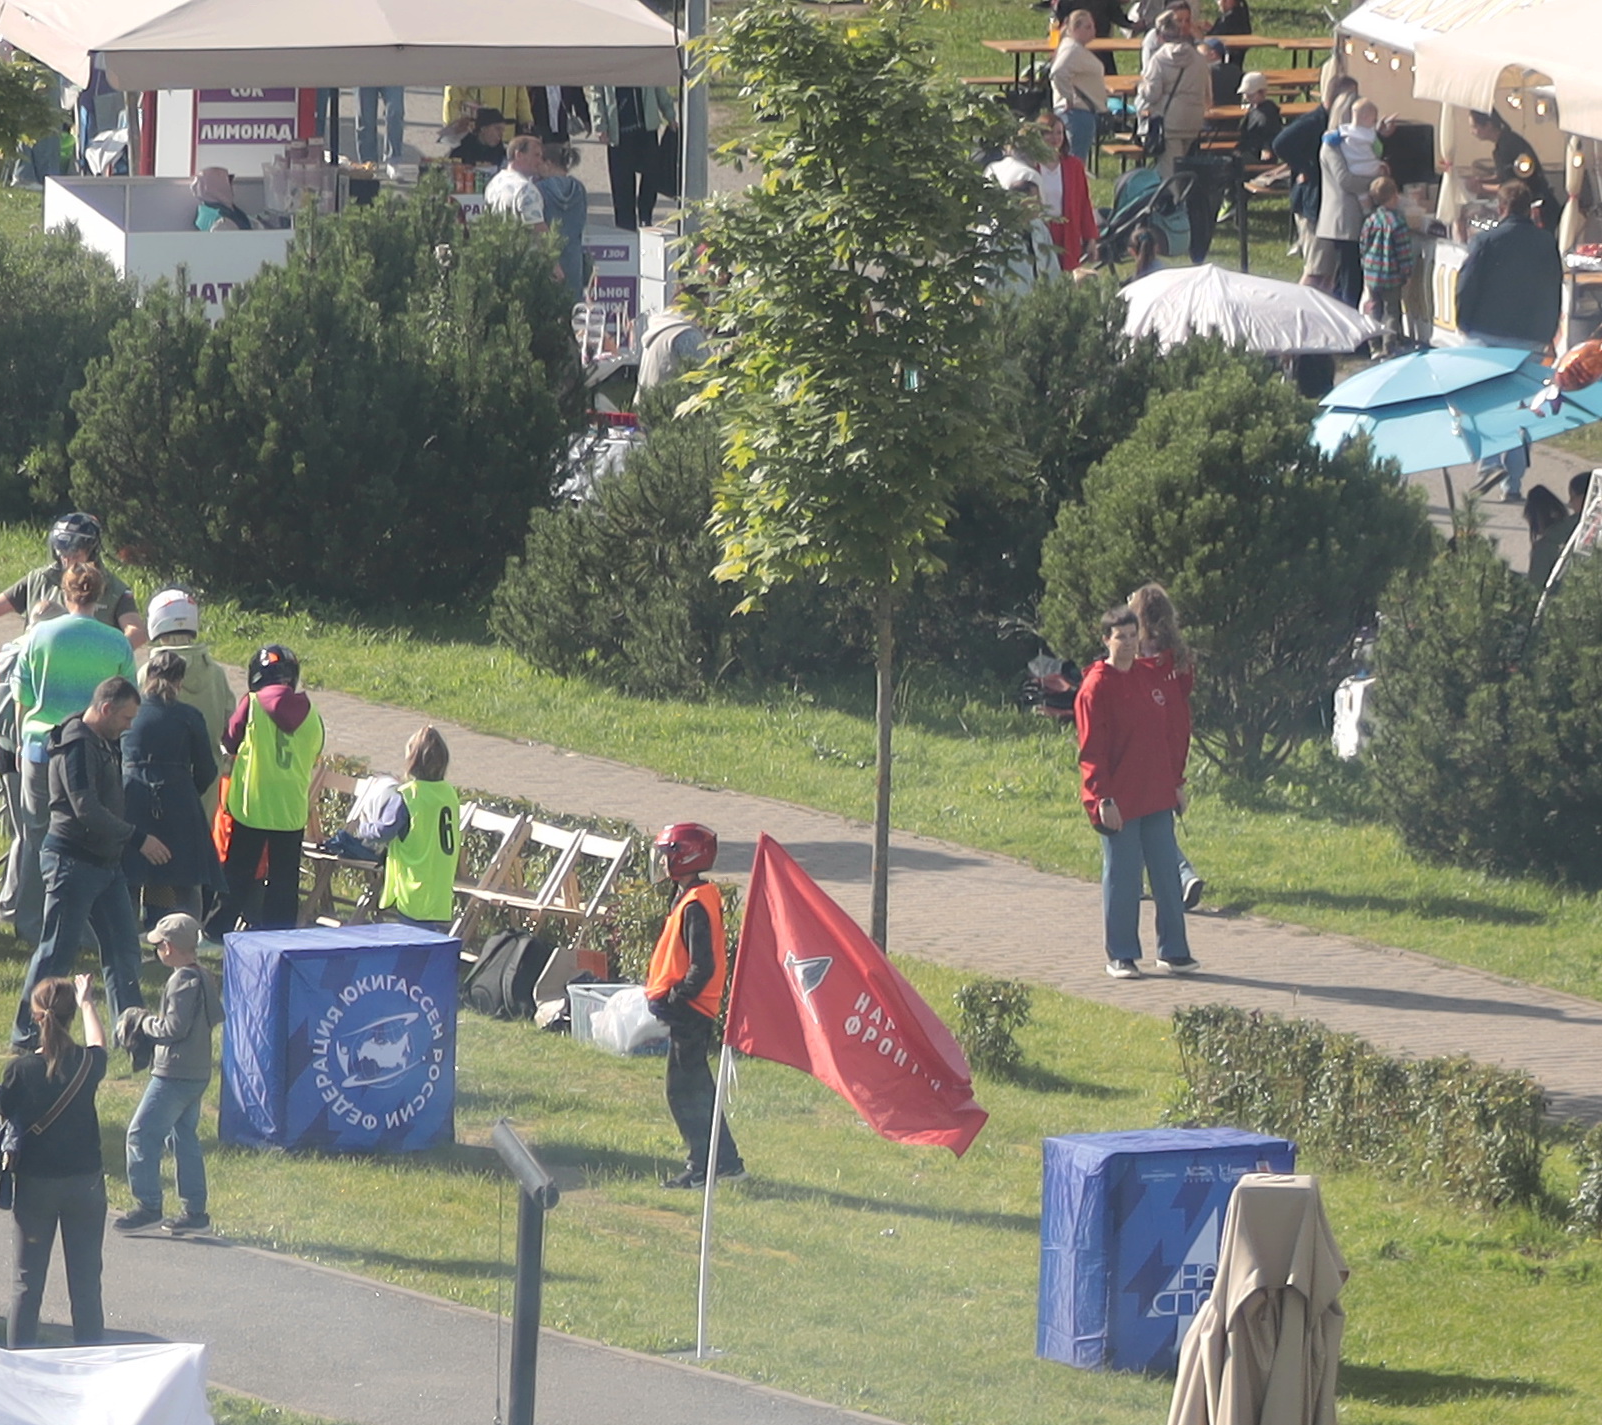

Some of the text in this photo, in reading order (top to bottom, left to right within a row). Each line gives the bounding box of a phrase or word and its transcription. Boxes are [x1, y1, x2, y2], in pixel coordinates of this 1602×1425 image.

[199, 123, 292, 142] ЛИМОНАД
[439, 805, 454, 855] 6
[312, 974, 444, 1131] ФЕДЕРАЦИЯ ЮКИГАССЕН РОССИИ
